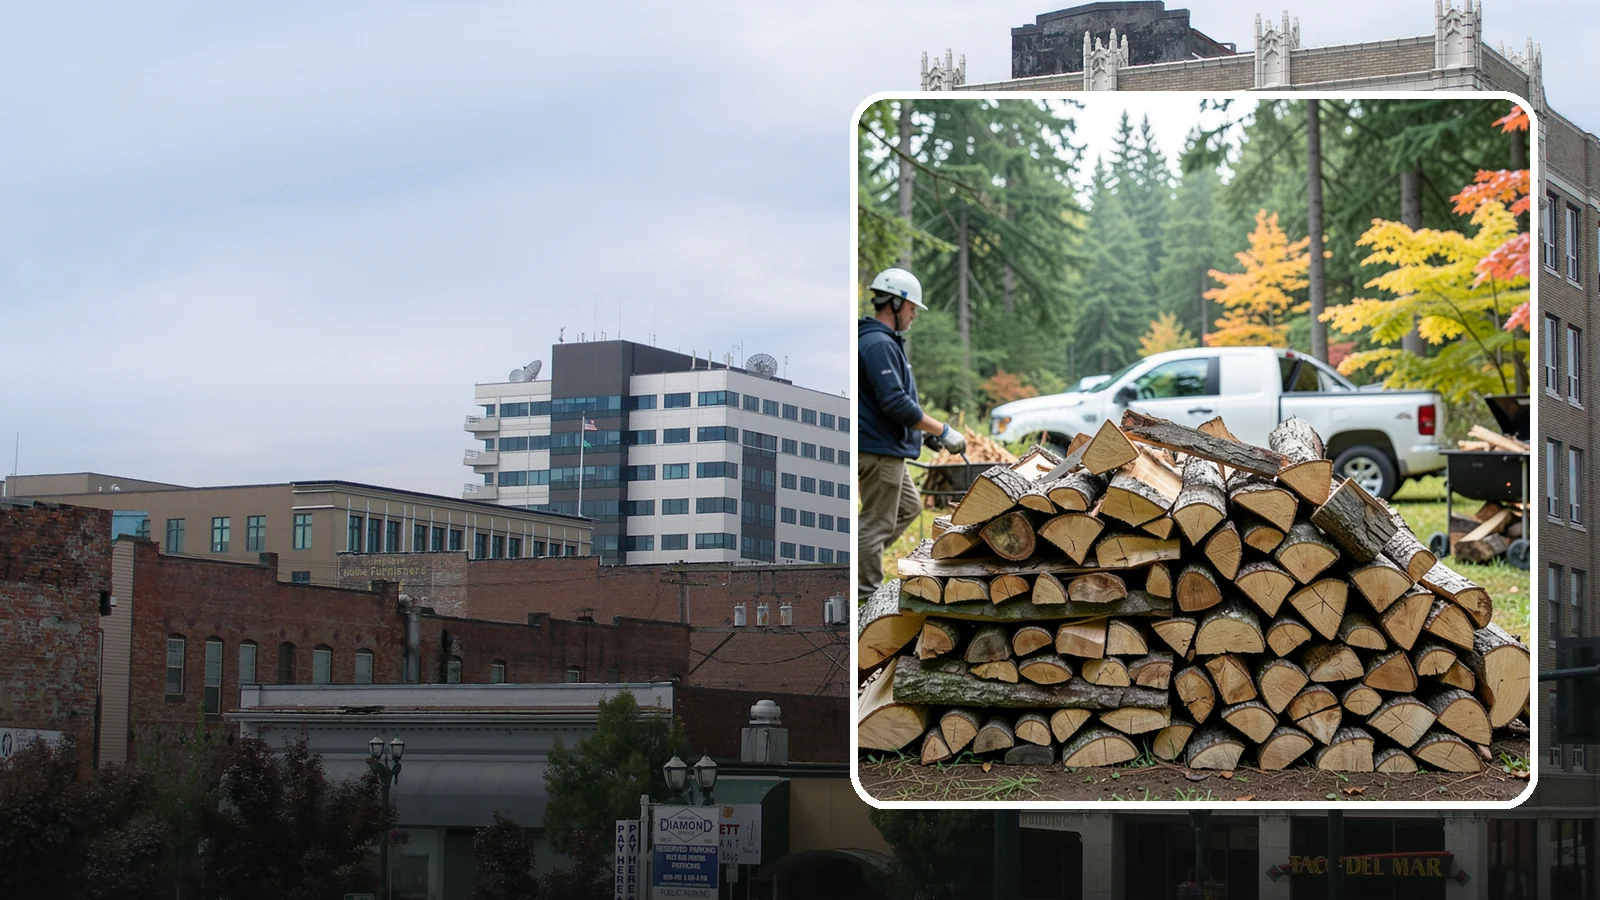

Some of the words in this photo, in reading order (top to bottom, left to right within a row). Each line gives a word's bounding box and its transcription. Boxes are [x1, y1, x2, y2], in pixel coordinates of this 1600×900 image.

[371, 566, 426, 576] Furnishers
[660, 818, 713, 832] DIAMOND
[1022, 815, 1069, 828] BUILDING
[719, 823, 740, 836] ETT
[617, 824, 625, 853] PAY
[628, 824, 637, 853] PAY
[720, 839, 739, 848] ANT
[671, 861, 701, 870] PATRONS
[1344, 856, 1384, 876] DEL
[1392, 857, 1443, 878] MAR
[616, 855, 625, 894] HERE
[627, 855, 637, 894] HERE
[684, 890, 709, 898] PARKING
